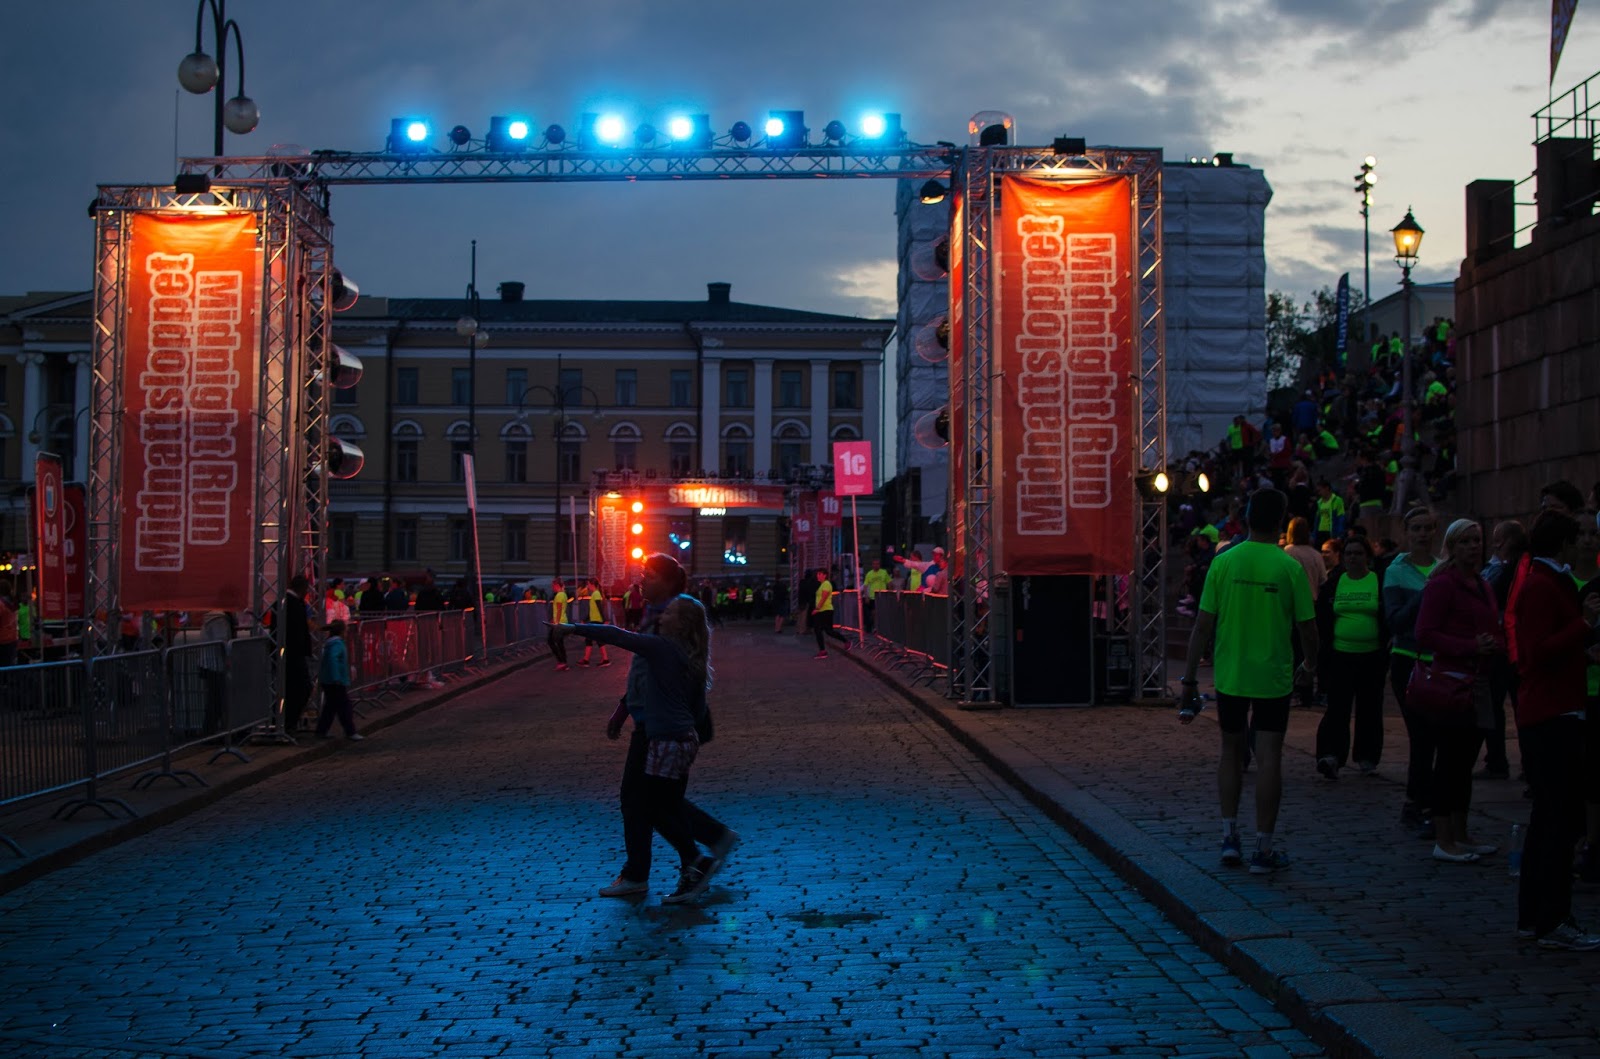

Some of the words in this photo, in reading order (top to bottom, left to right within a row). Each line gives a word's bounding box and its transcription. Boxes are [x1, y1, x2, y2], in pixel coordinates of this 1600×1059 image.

[188, 270, 243, 457] Midnight
[1016, 215, 1066, 536] Midnattsloppet
[1067, 232, 1117, 420] Midnight
[135, 252, 195, 572] Midnattsloppet
[839, 450, 867, 476] 1c
[1068, 422, 1117, 509] Run
[188, 460, 238, 545] Run
[668, 486, 758, 504] Start/Finish
